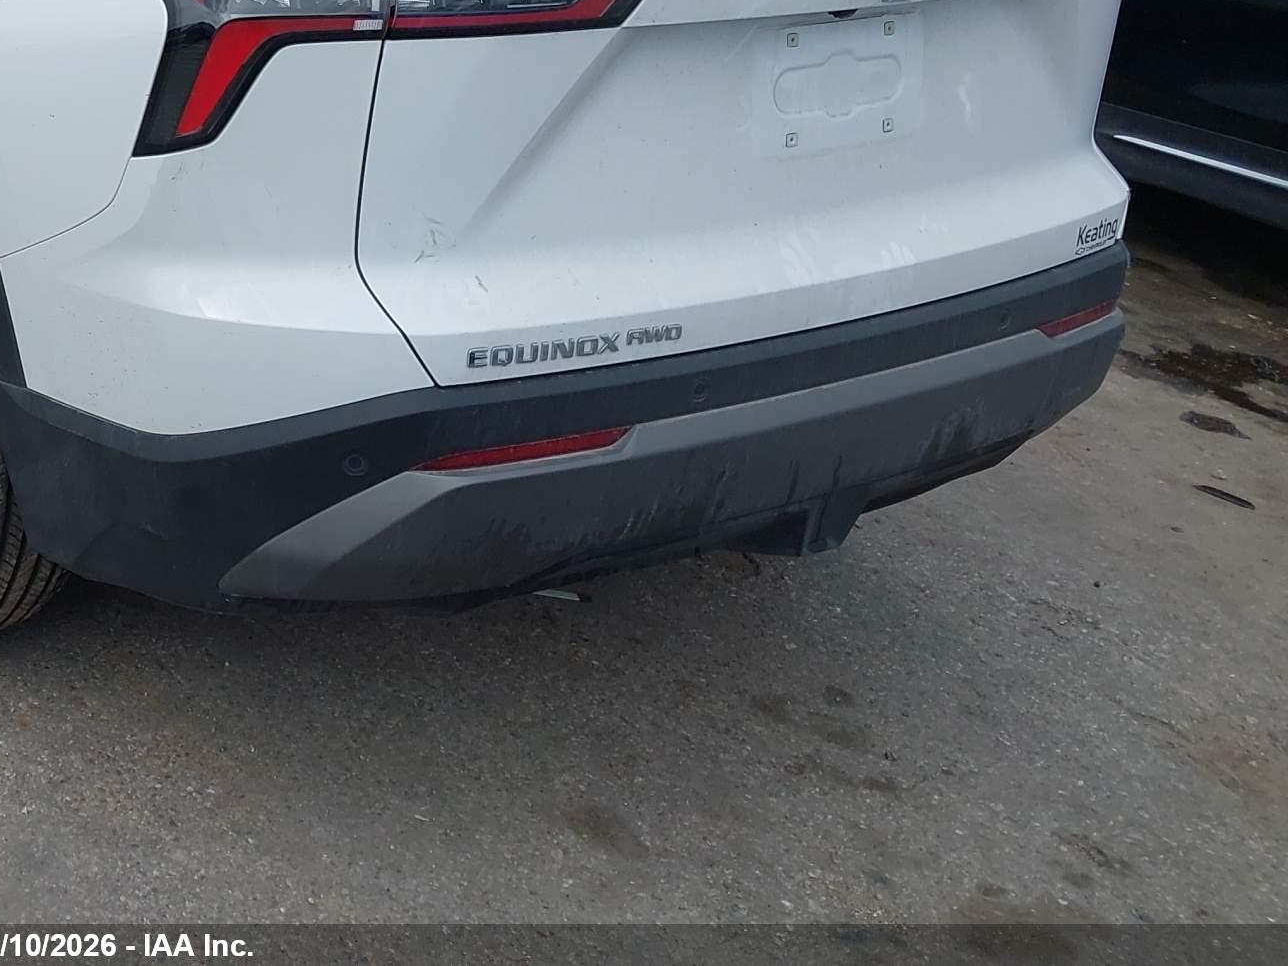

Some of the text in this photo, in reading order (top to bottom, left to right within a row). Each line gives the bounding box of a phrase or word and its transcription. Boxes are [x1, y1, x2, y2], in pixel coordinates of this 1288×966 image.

[1076, 217, 1119, 247] Keating
[467, 324, 683, 369] EQUINOX AWD
